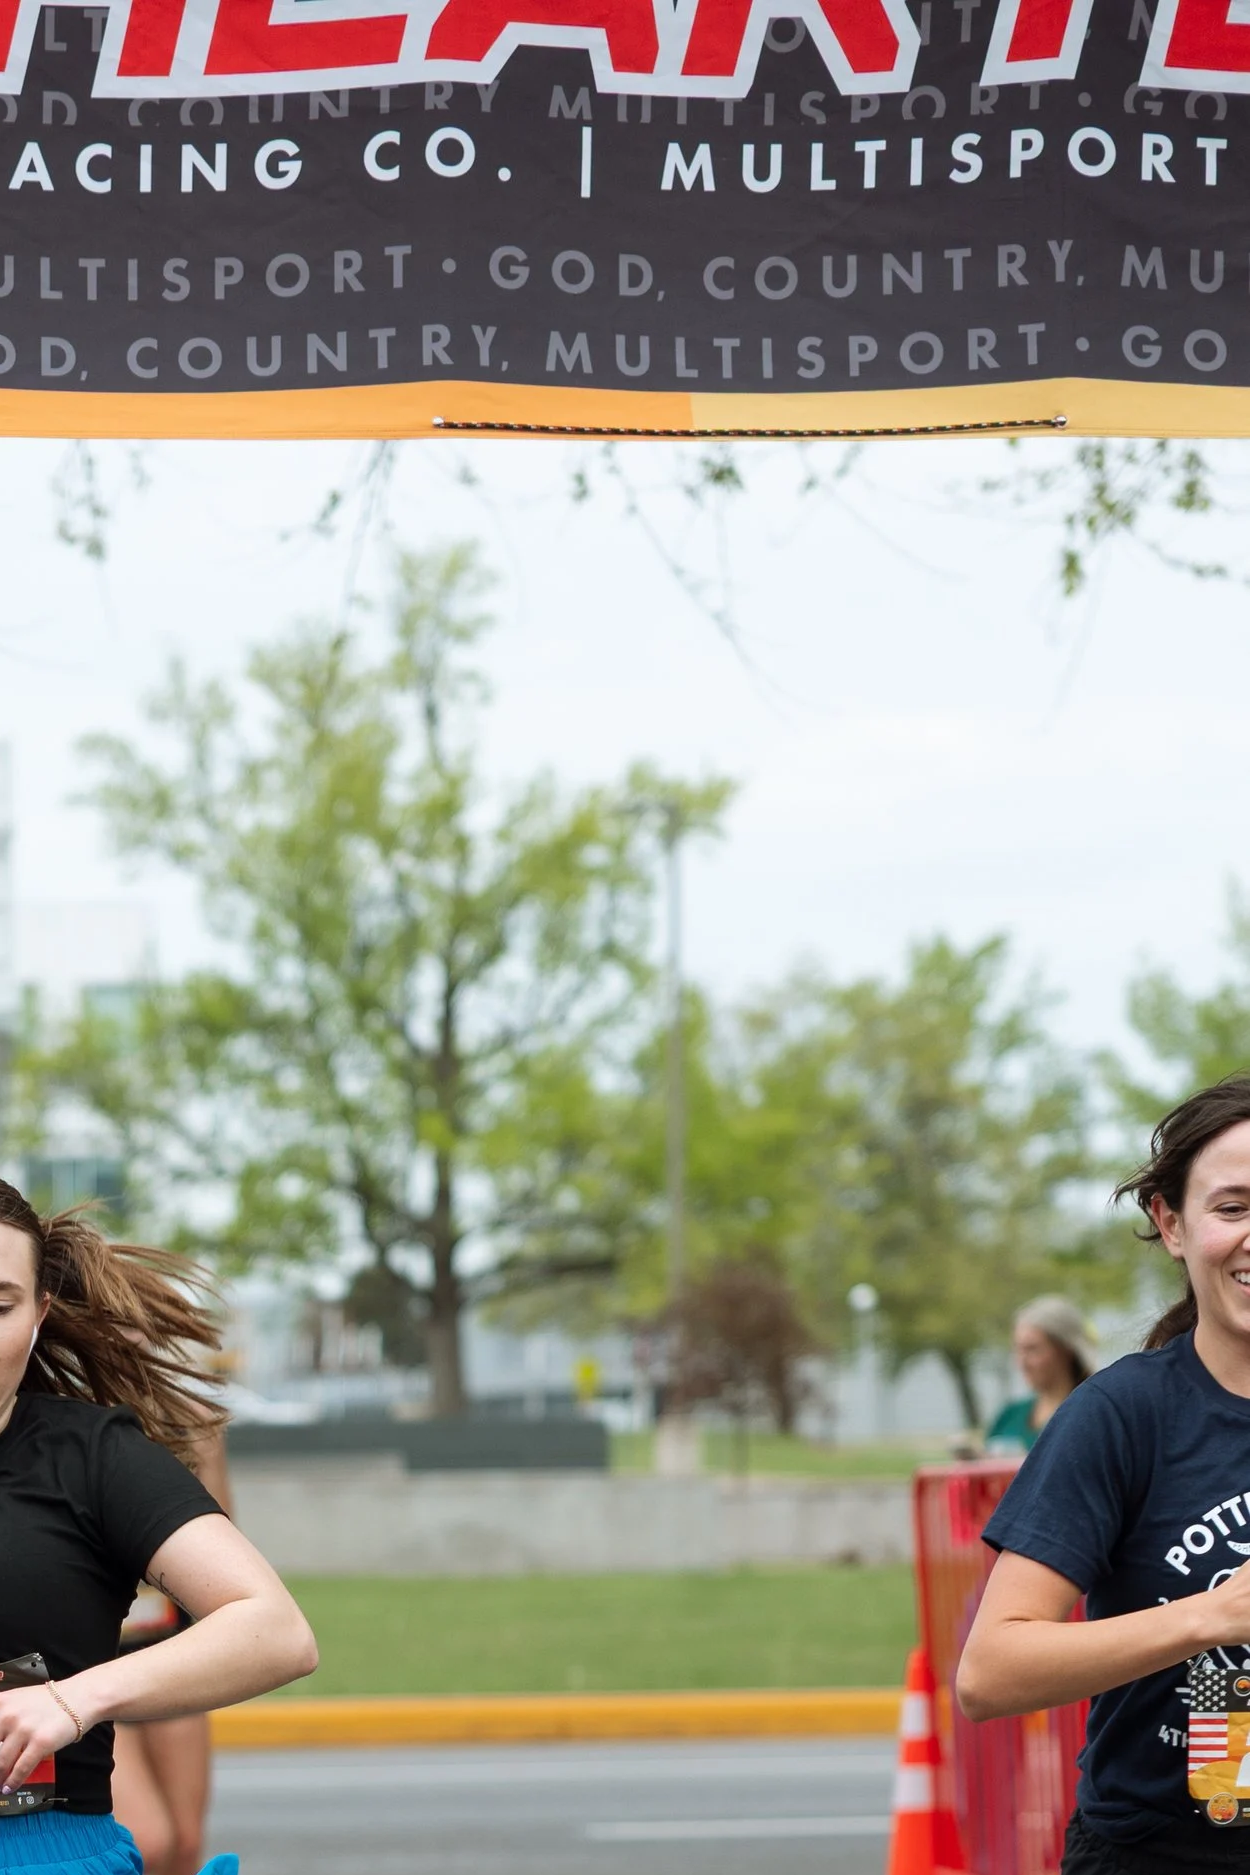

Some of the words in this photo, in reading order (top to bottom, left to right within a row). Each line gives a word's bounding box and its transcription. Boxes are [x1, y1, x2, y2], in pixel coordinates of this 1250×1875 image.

[363, 126, 512, 182] CO.
[660, 126, 1228, 194] MULTISPORT
[489, 245, 665, 302] GOD,
[703, 239, 1084, 301] COUNTRY,
[1121, 244, 1250, 294] MU
[126, 323, 509, 380] COUNTRY,
[545, 323, 1047, 380] MULTISPORT
[1164, 1491, 1250, 1576] POTT
